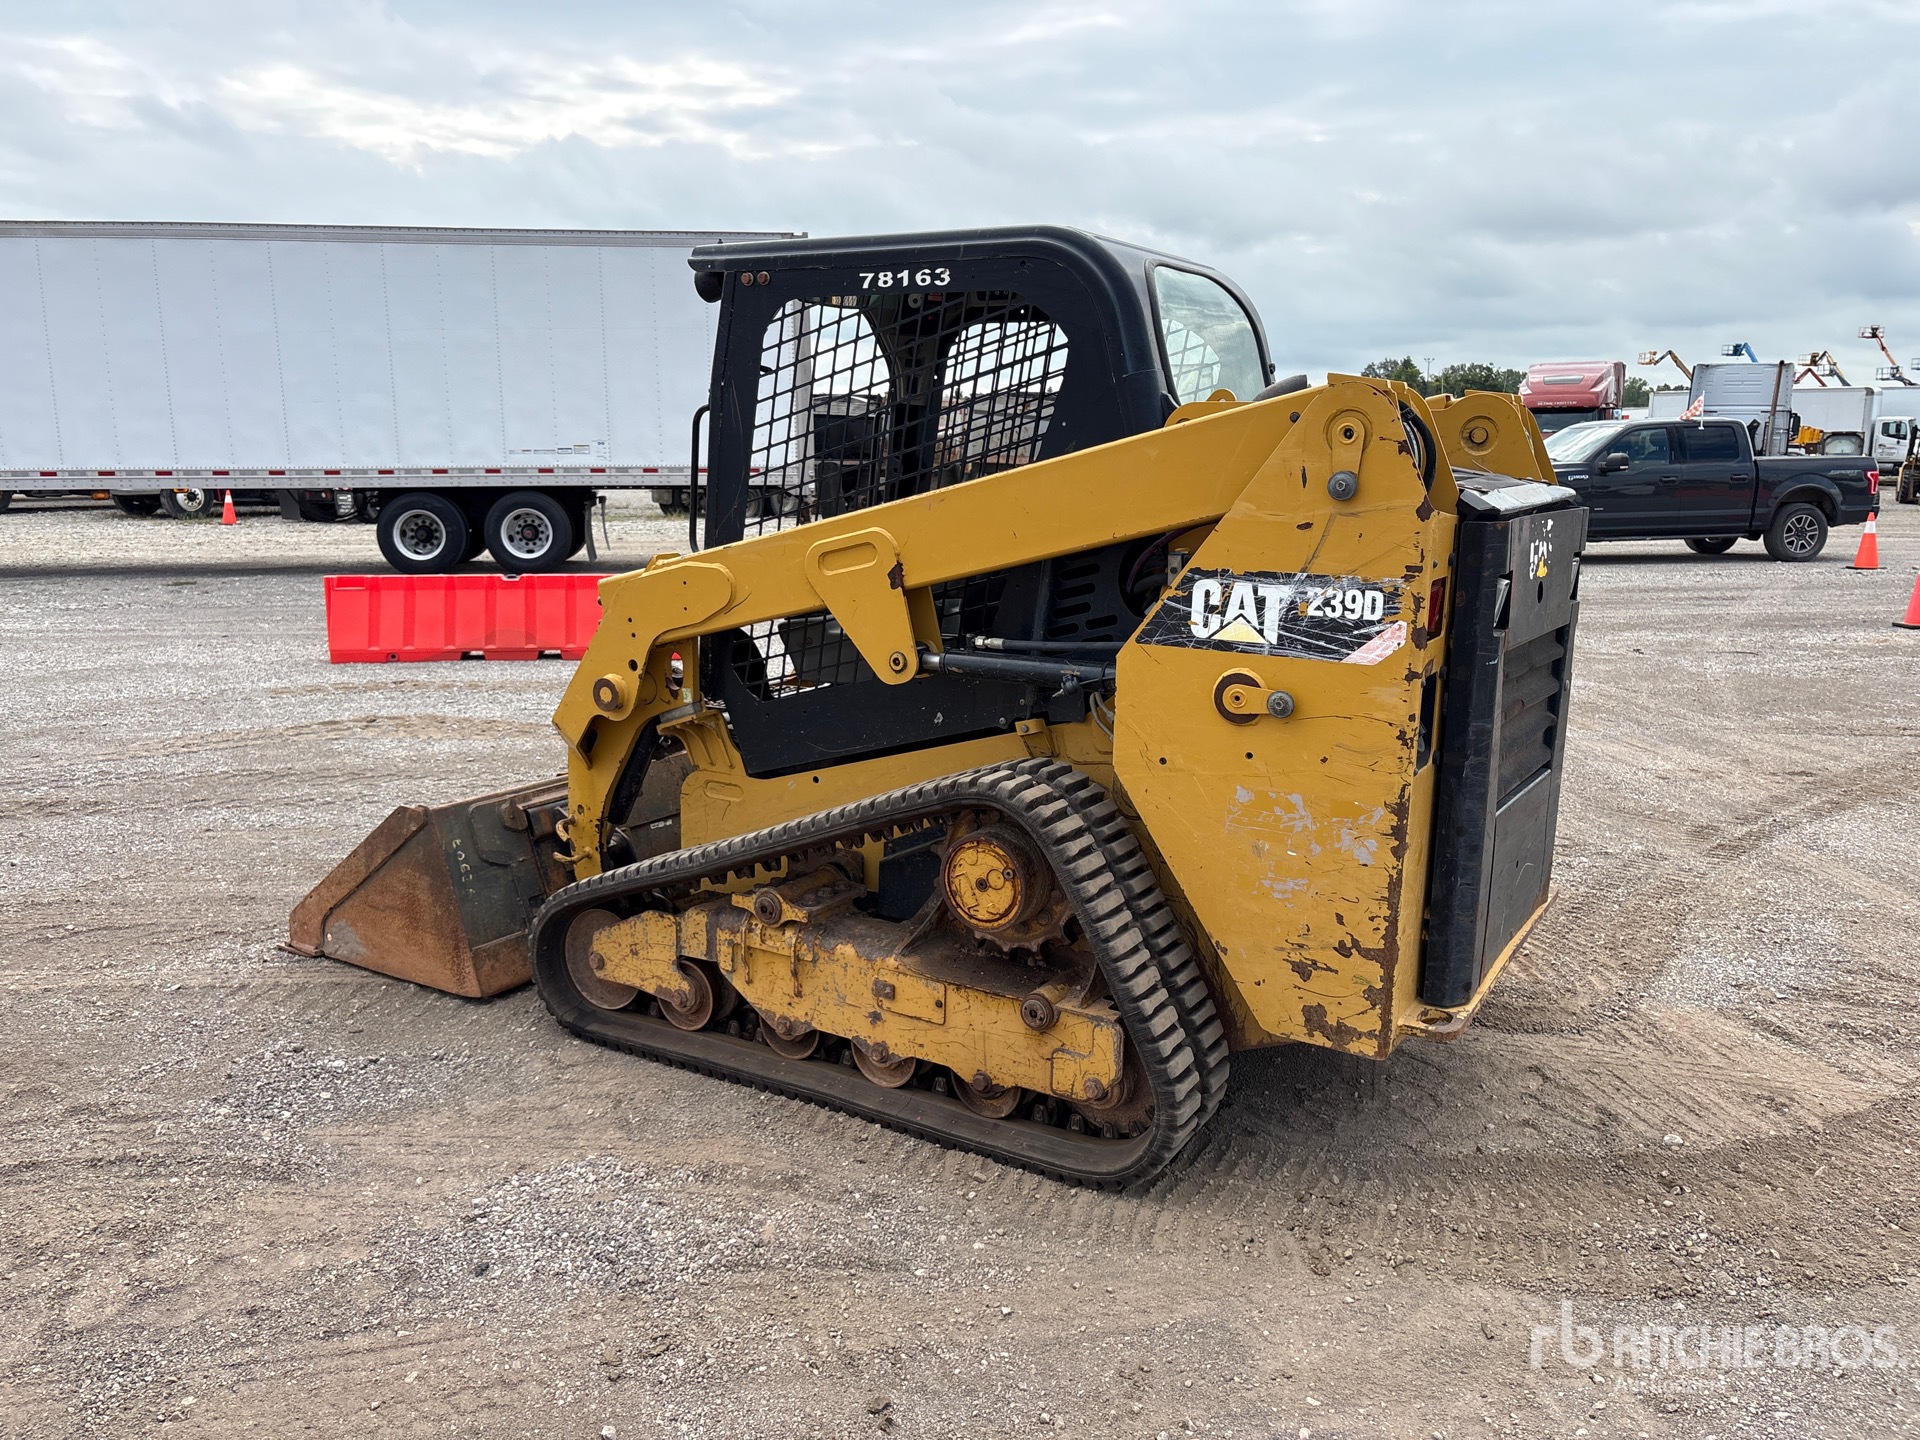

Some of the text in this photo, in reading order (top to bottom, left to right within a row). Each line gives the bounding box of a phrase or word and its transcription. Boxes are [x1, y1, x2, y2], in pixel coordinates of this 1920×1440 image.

[859, 268, 951, 289] 78163
[1190, 578, 1384, 645] CAT 239D
